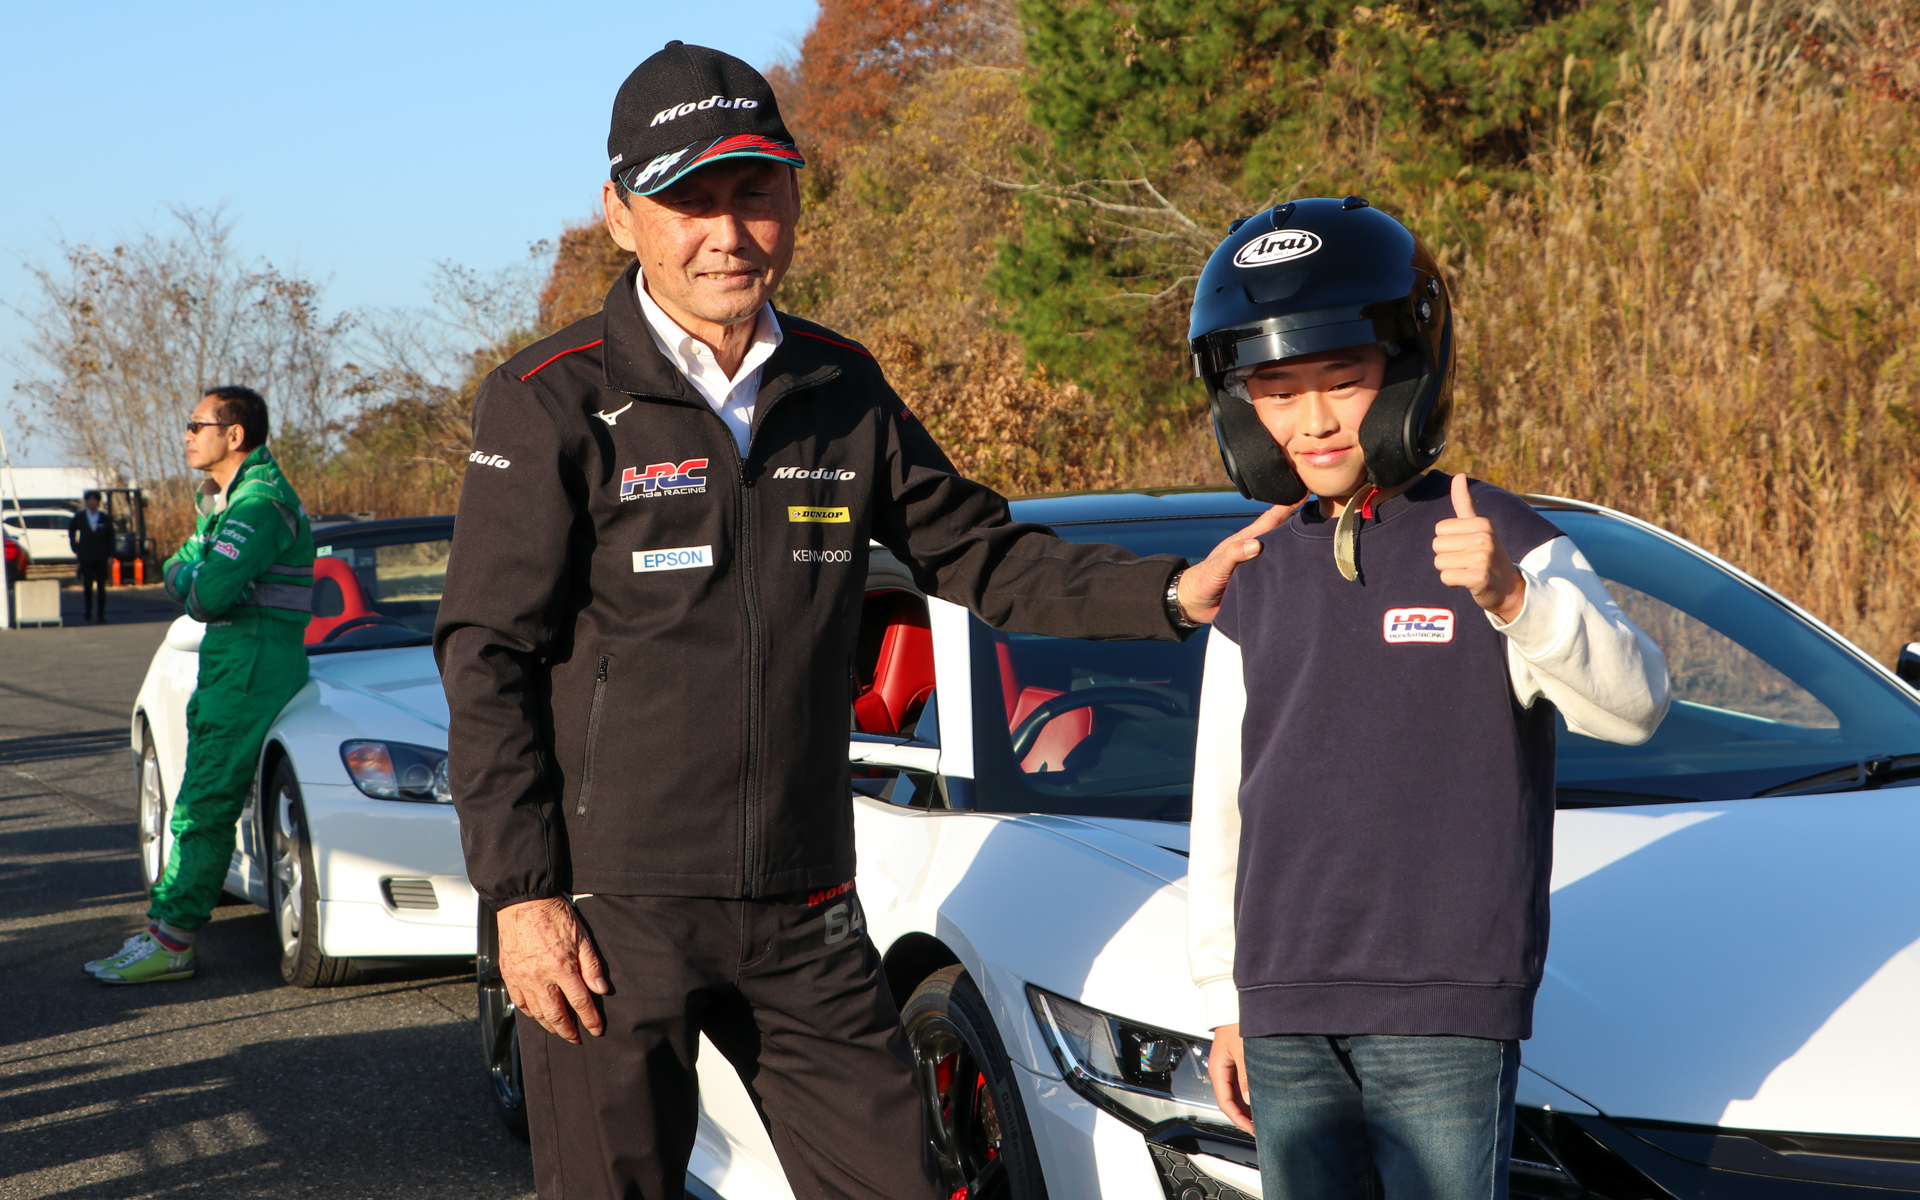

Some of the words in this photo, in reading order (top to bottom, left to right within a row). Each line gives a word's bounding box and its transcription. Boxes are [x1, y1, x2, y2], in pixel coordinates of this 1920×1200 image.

[650, 95, 759, 128] Modulo
[634, 148, 690, 188] 64
[1239, 233, 1308, 263] Arai
[620, 458, 709, 497] HRC
[772, 466, 857, 482] Modulo
[620, 490, 662, 503] Honda
[664, 486, 707, 496] RACING
[801, 510, 844, 521] DUNLOP
[644, 549, 704, 569] EPSON
[792, 549, 852, 564] KENWOOD
[1391, 613, 1449, 631] HRC
[823, 897, 864, 945] 64
